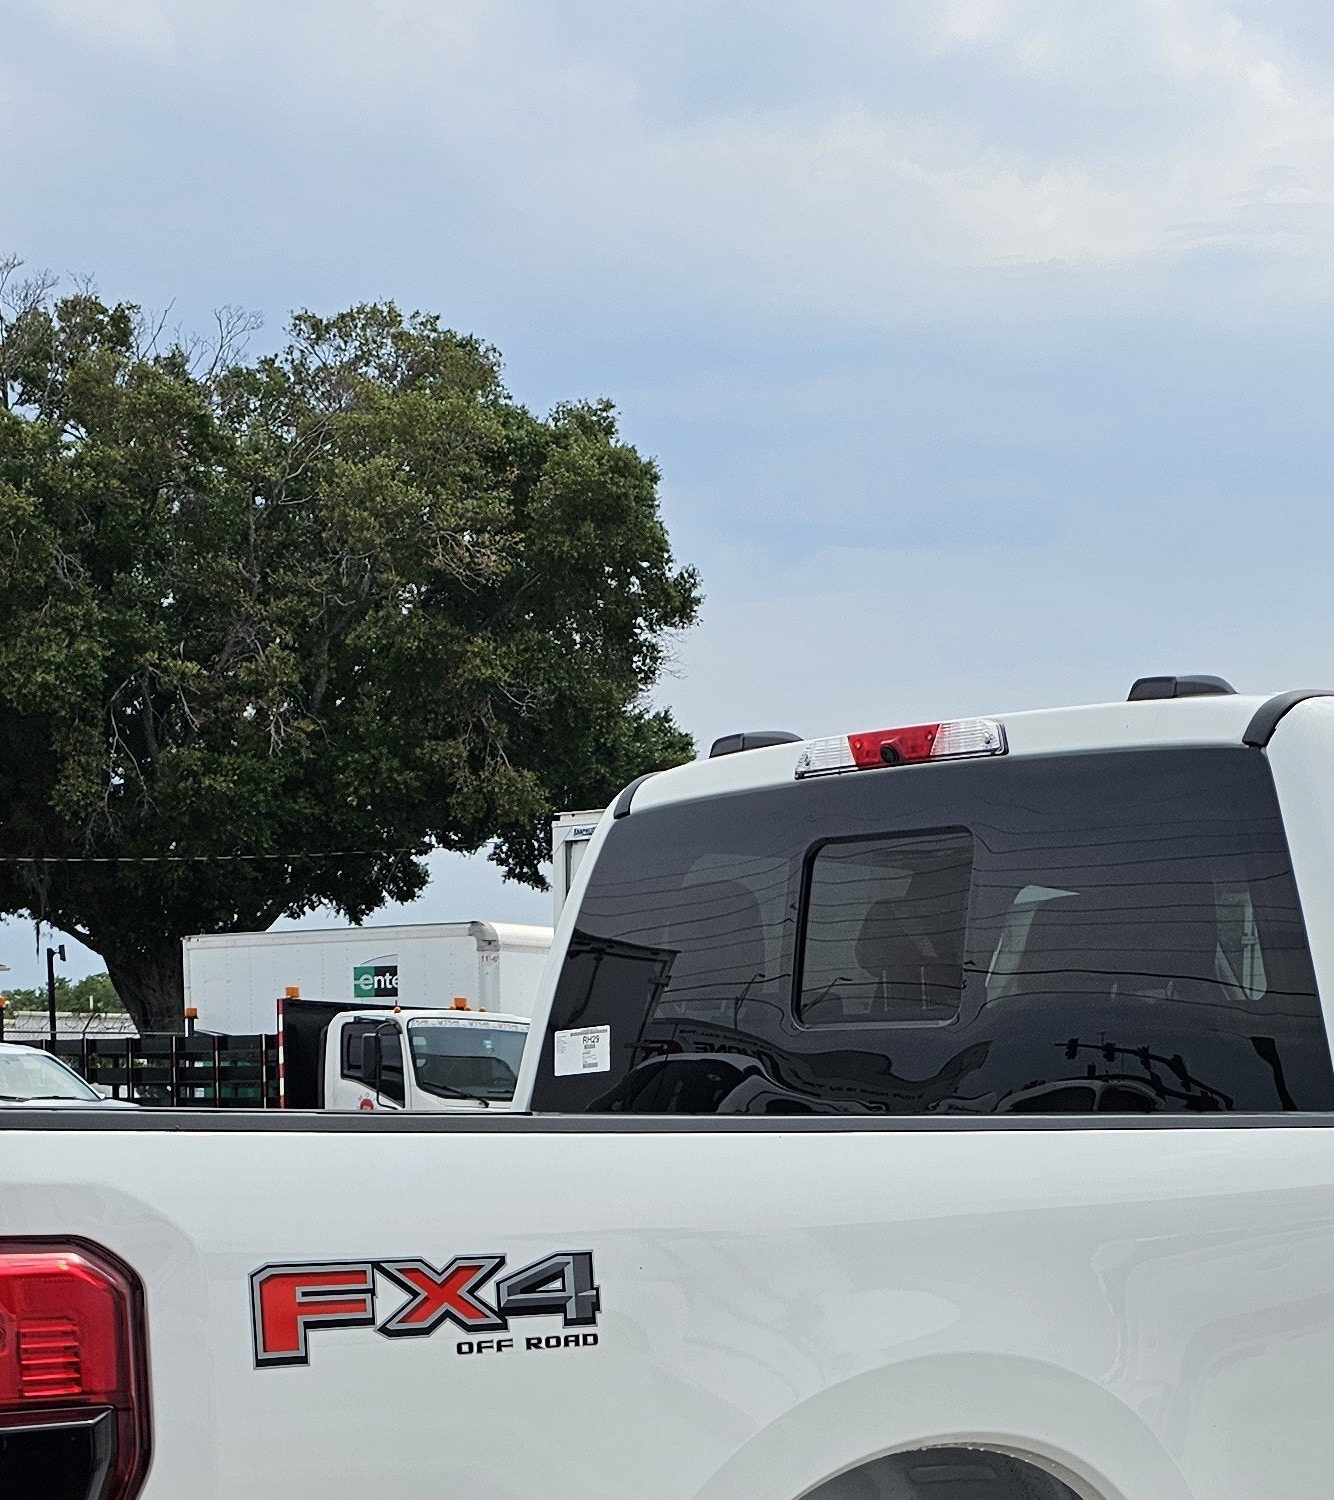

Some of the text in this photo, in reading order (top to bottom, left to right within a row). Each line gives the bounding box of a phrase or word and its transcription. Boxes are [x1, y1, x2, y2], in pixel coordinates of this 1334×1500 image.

[248, 1249, 602, 1370] FX4
[456, 1332, 599, 1355] OFF ROAD
